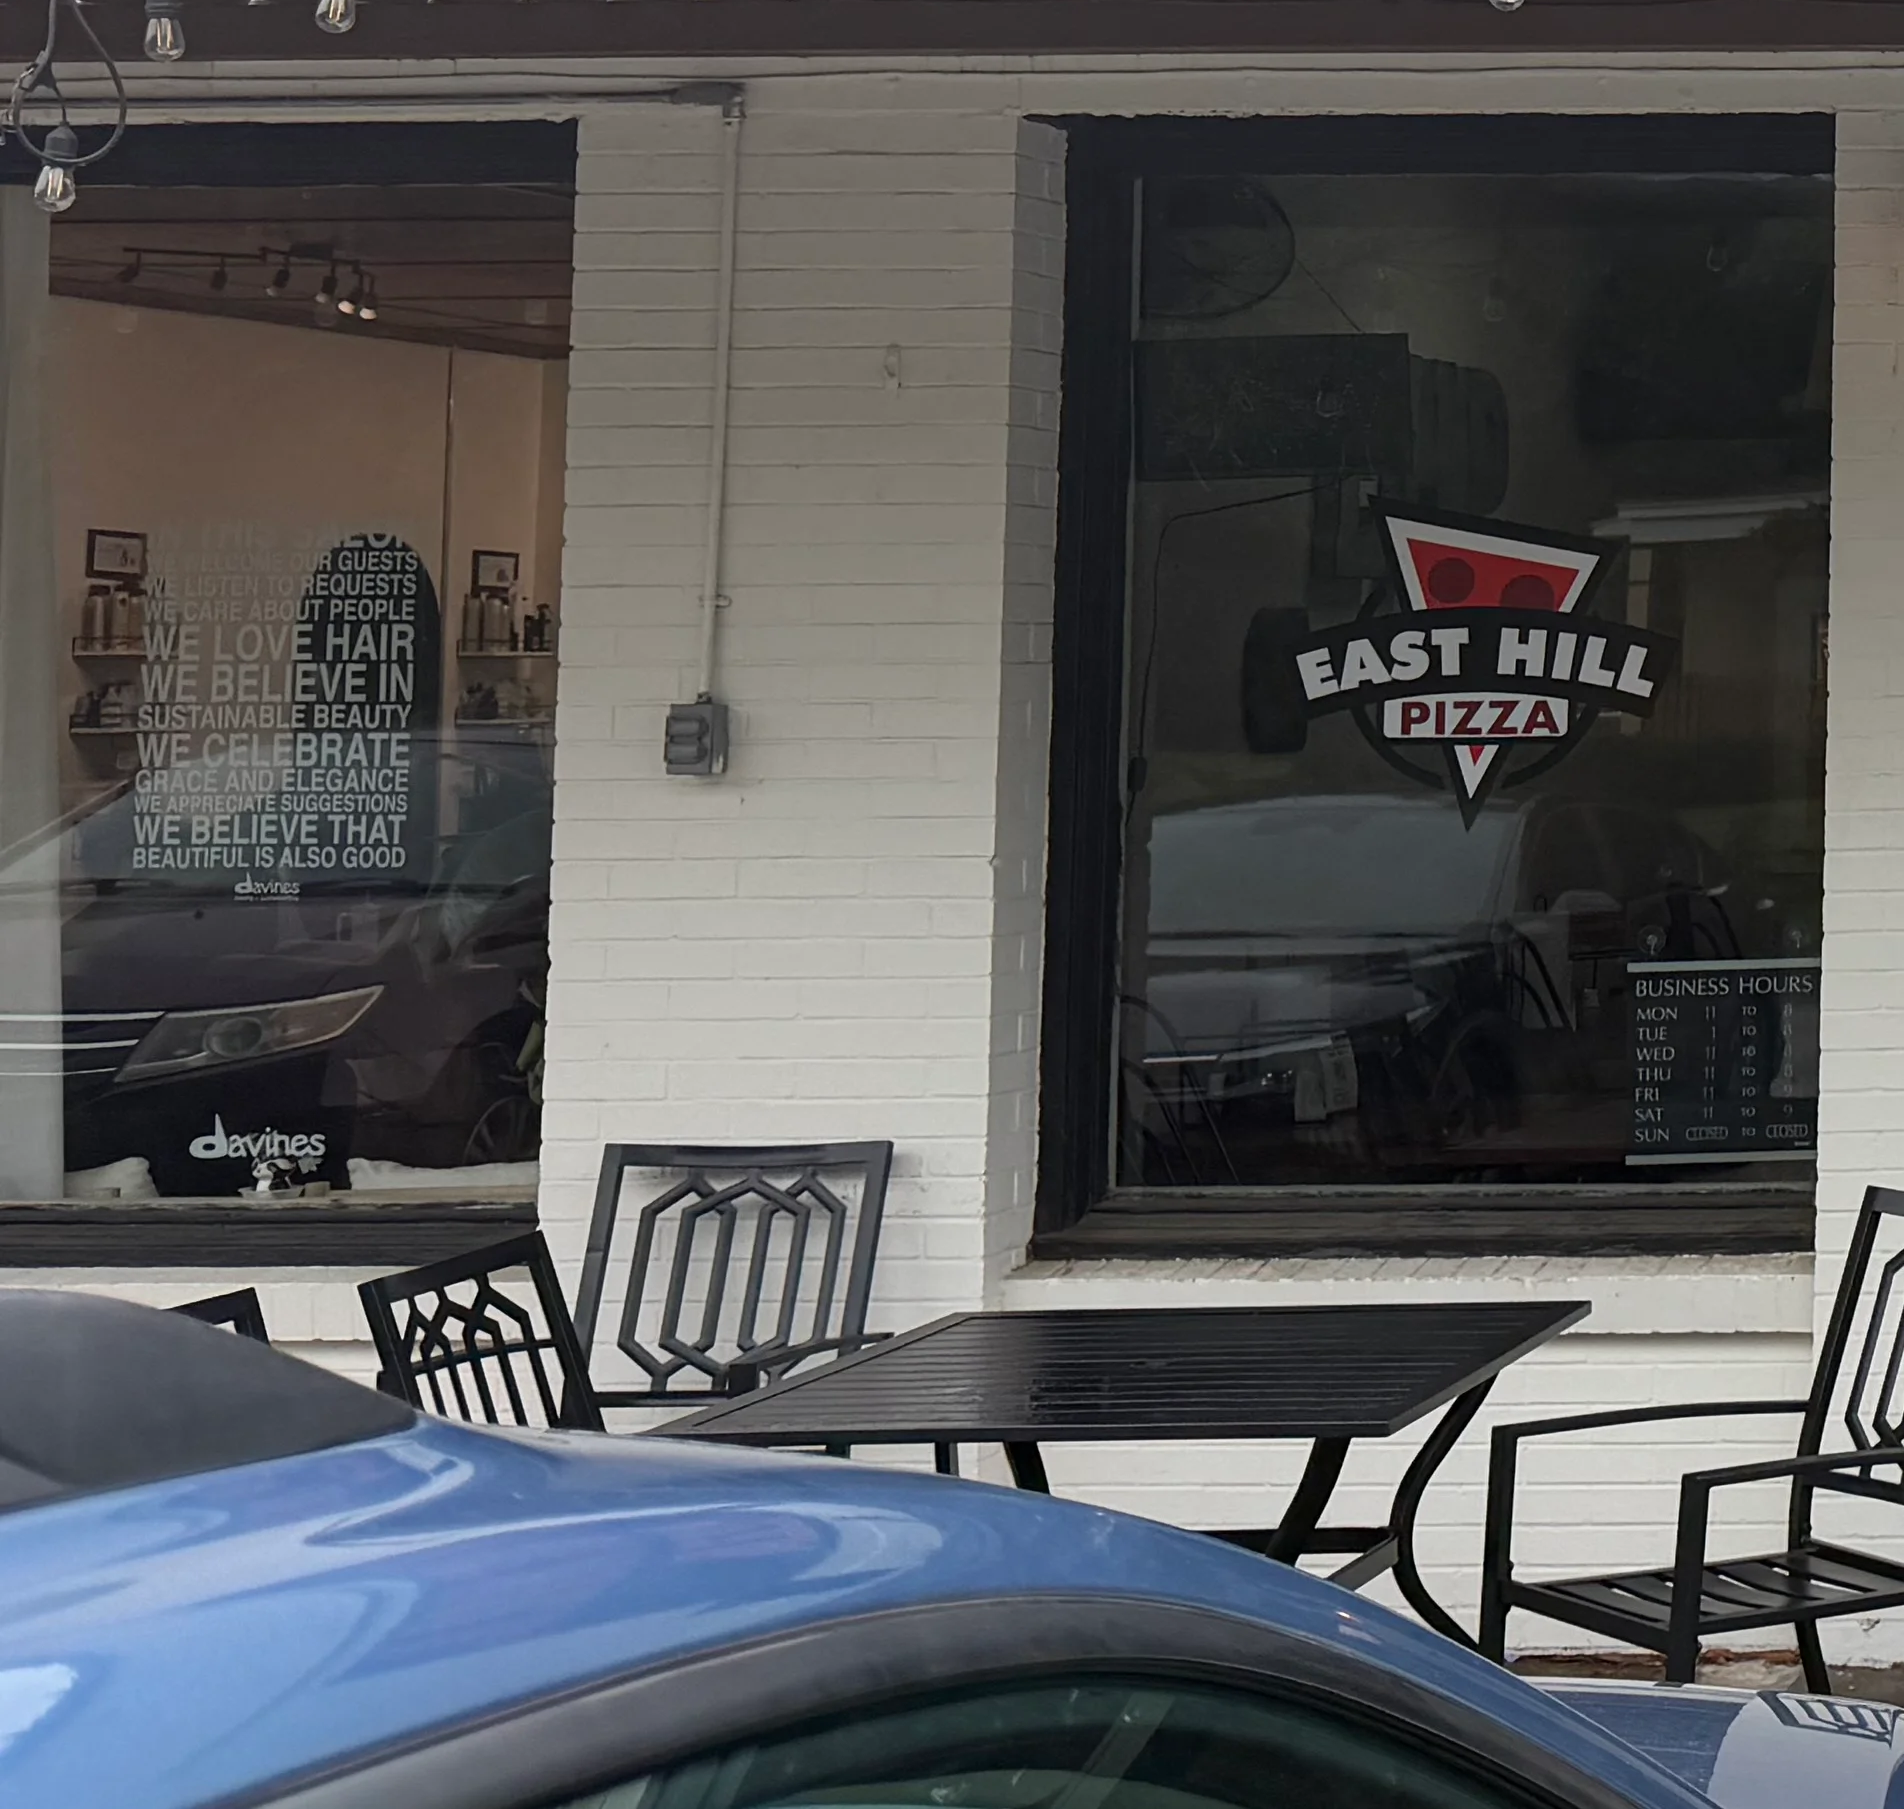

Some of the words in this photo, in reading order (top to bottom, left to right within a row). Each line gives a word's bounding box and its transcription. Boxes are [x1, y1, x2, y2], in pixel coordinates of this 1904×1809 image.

[290, 551, 332, 572] OUR
[338, 550, 418, 572] GUESTS
[145, 574, 177, 597] WE
[184, 575, 260, 597] LISTEN
[266, 575, 294, 597] TO
[300, 574, 417, 596] REQUESTS
[143, 599, 177, 621] WE
[183, 599, 243, 621] CARE
[250, 599, 323, 621] ABOUT
[329, 599, 415, 621] PEOPLE
[142, 624, 200, 661] WE
[214, 624, 314, 661] LOVE
[326, 624, 415, 661] HAIR
[1296, 627, 1469, 701] EAST
[1497, 627, 1655, 698] HILL
[140, 662, 199, 703] WE
[210, 662, 367, 703] BELIEVE
[379, 662, 414, 702] IN
[138, 704, 306, 730] SUSTAINABLE
[313, 704, 412, 729] BEAUTY
[1400, 700, 1560, 736] PIZZA
[136, 732, 192, 768] WE
[202, 732, 411, 768] CELEBRATE
[135, 769, 218, 793] GRACE
[224, 769, 274, 793] AND
[281, 768, 409, 792] ELEGANCE
[134, 795, 161, 813] WE
[167, 795, 276, 813] APPRECIATE
[280, 794, 408, 813] SUGGESTIONS
[133, 814, 181, 845] WE
[191, 814, 319, 845] BELIEVE
[328, 814, 407, 845] THAT
[132, 847, 250, 869] BEAUTIFUL
[255, 847, 275, 869] IS
[279, 847, 337, 869] ALSO
[342, 846, 406, 869] GOOD
[234, 872, 300, 894] davines
[1635, 977, 1730, 997] BUSINESS
[1739, 975, 1813, 994] HOURS
[1636, 1006, 1678, 1022] MON
[1637, 1026, 1668, 1041] TUE
[1636, 1046, 1676, 1061] WED
[1637, 1067, 1672, 1082] THU
[1635, 1087, 1660, 1102] FRI
[1635, 1107, 1665, 1122] SAT
[189, 1113, 326, 1159] davines
[1635, 1128, 1670, 1142] SUN
